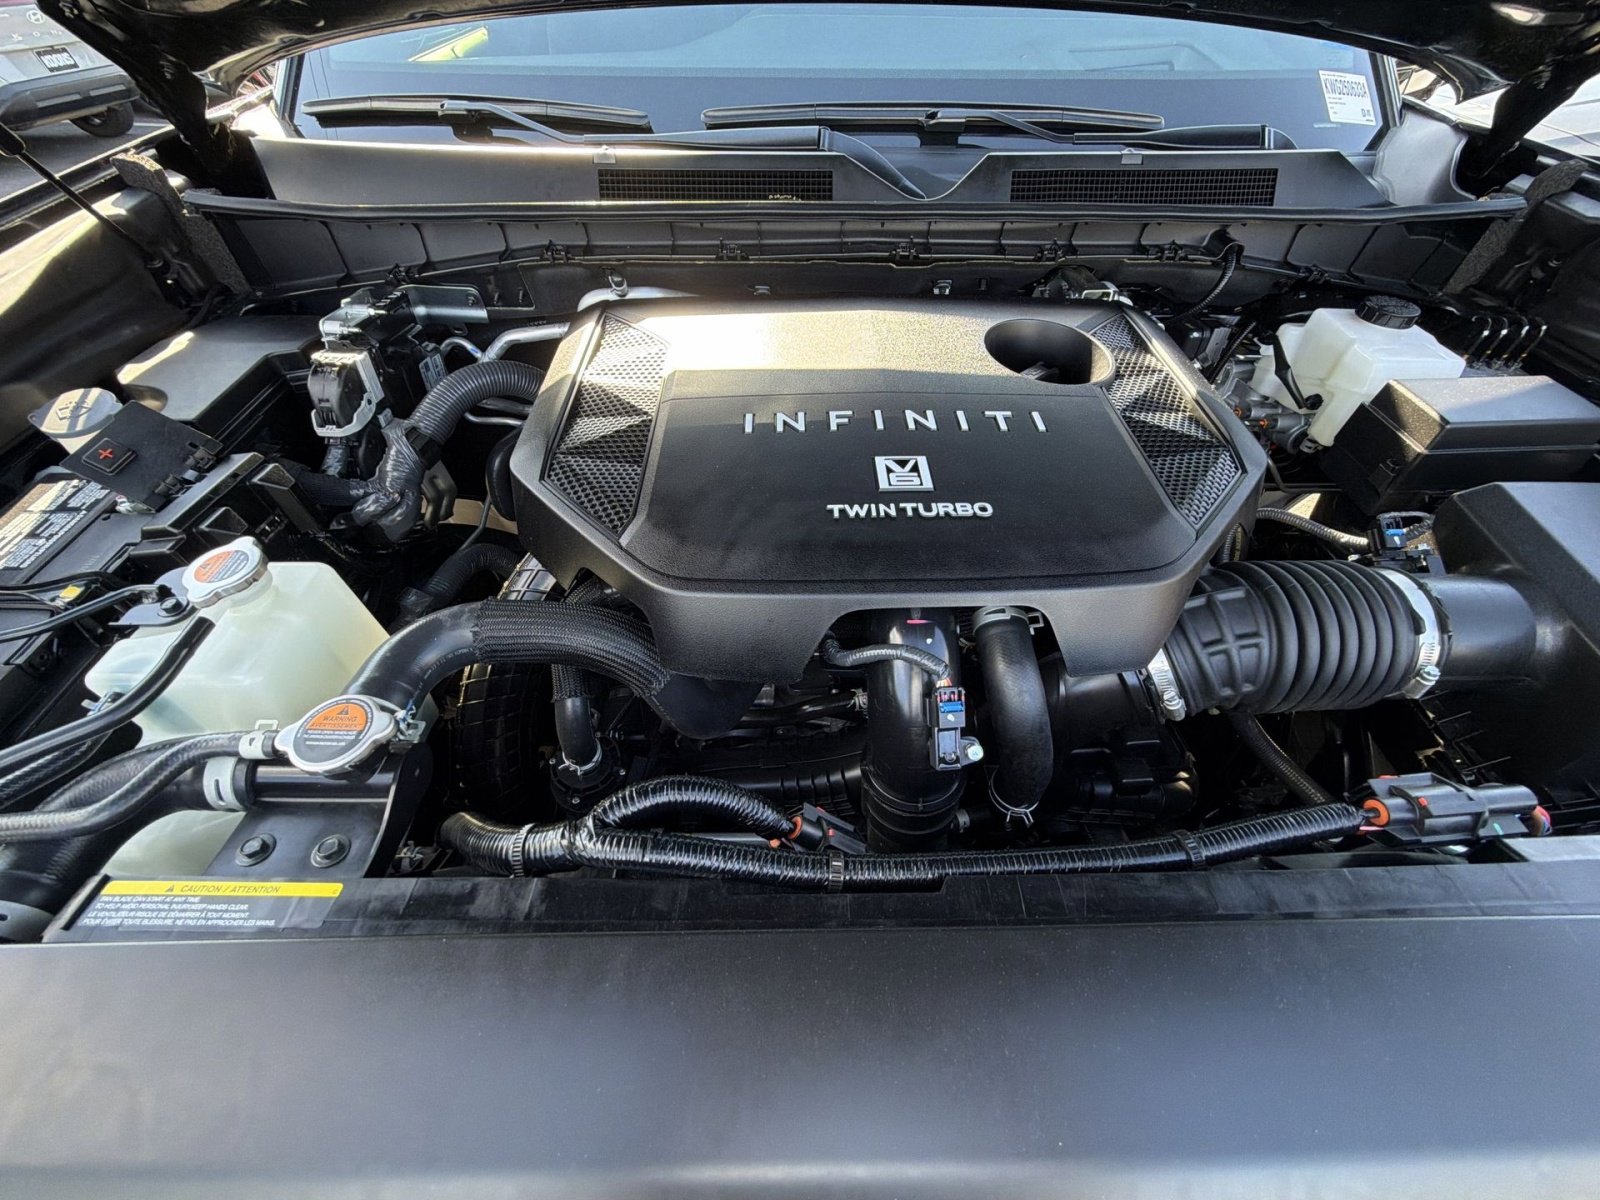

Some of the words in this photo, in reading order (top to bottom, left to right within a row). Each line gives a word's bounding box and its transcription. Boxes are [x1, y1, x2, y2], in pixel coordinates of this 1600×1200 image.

[743, 409, 1047, 435] INFINITI
[826, 503, 898, 519] TWIN
[898, 502, 994, 518] TURBO
[180, 885, 221, 893] CAUTION
[230, 885, 280, 894] ATTENTION
